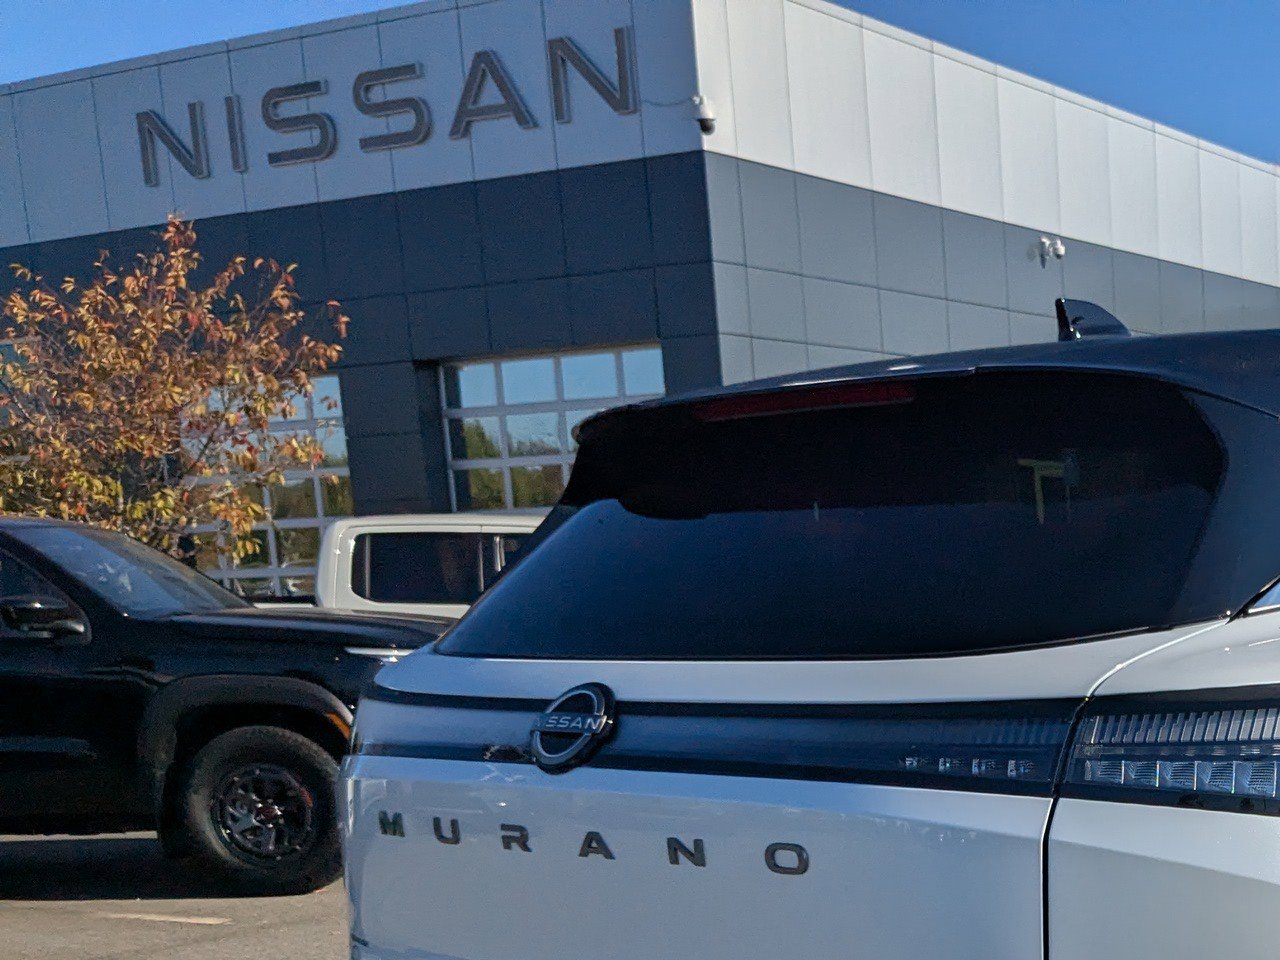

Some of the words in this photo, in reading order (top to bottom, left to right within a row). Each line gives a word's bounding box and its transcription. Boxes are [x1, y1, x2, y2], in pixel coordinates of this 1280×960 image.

[135, 26, 635, 187] NISSAN
[533, 715, 601, 730] SSAN
[379, 810, 810, 876] MURANO
